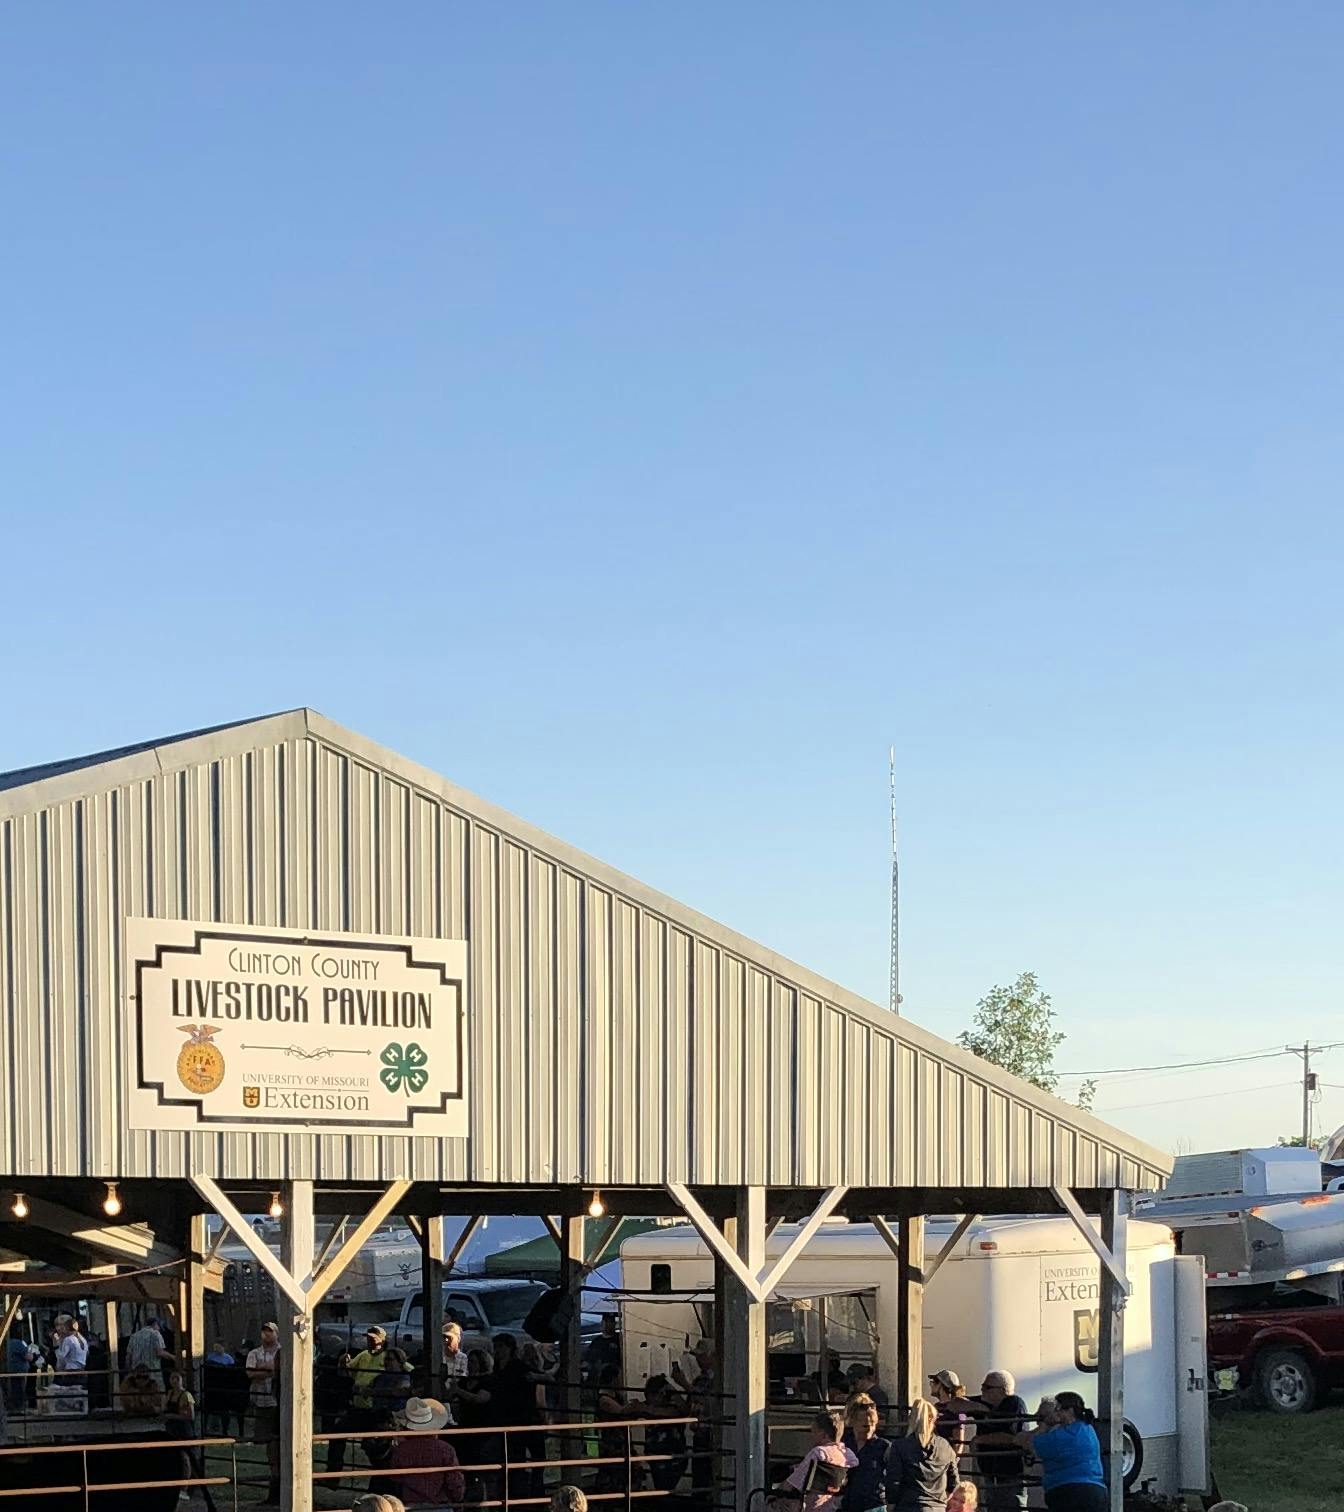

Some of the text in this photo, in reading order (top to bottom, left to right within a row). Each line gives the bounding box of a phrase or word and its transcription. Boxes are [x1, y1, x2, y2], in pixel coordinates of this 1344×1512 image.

[228, 947, 380, 981] CLINTON COUNTY
[172, 978, 432, 1030] LIVESTOCK PAVILION
[241, 1073, 370, 1088] UNIVERSITY OF MISSOURI
[264, 1087, 370, 1111] Extension
[1044, 1267, 1089, 1279] UNIVERSITY
